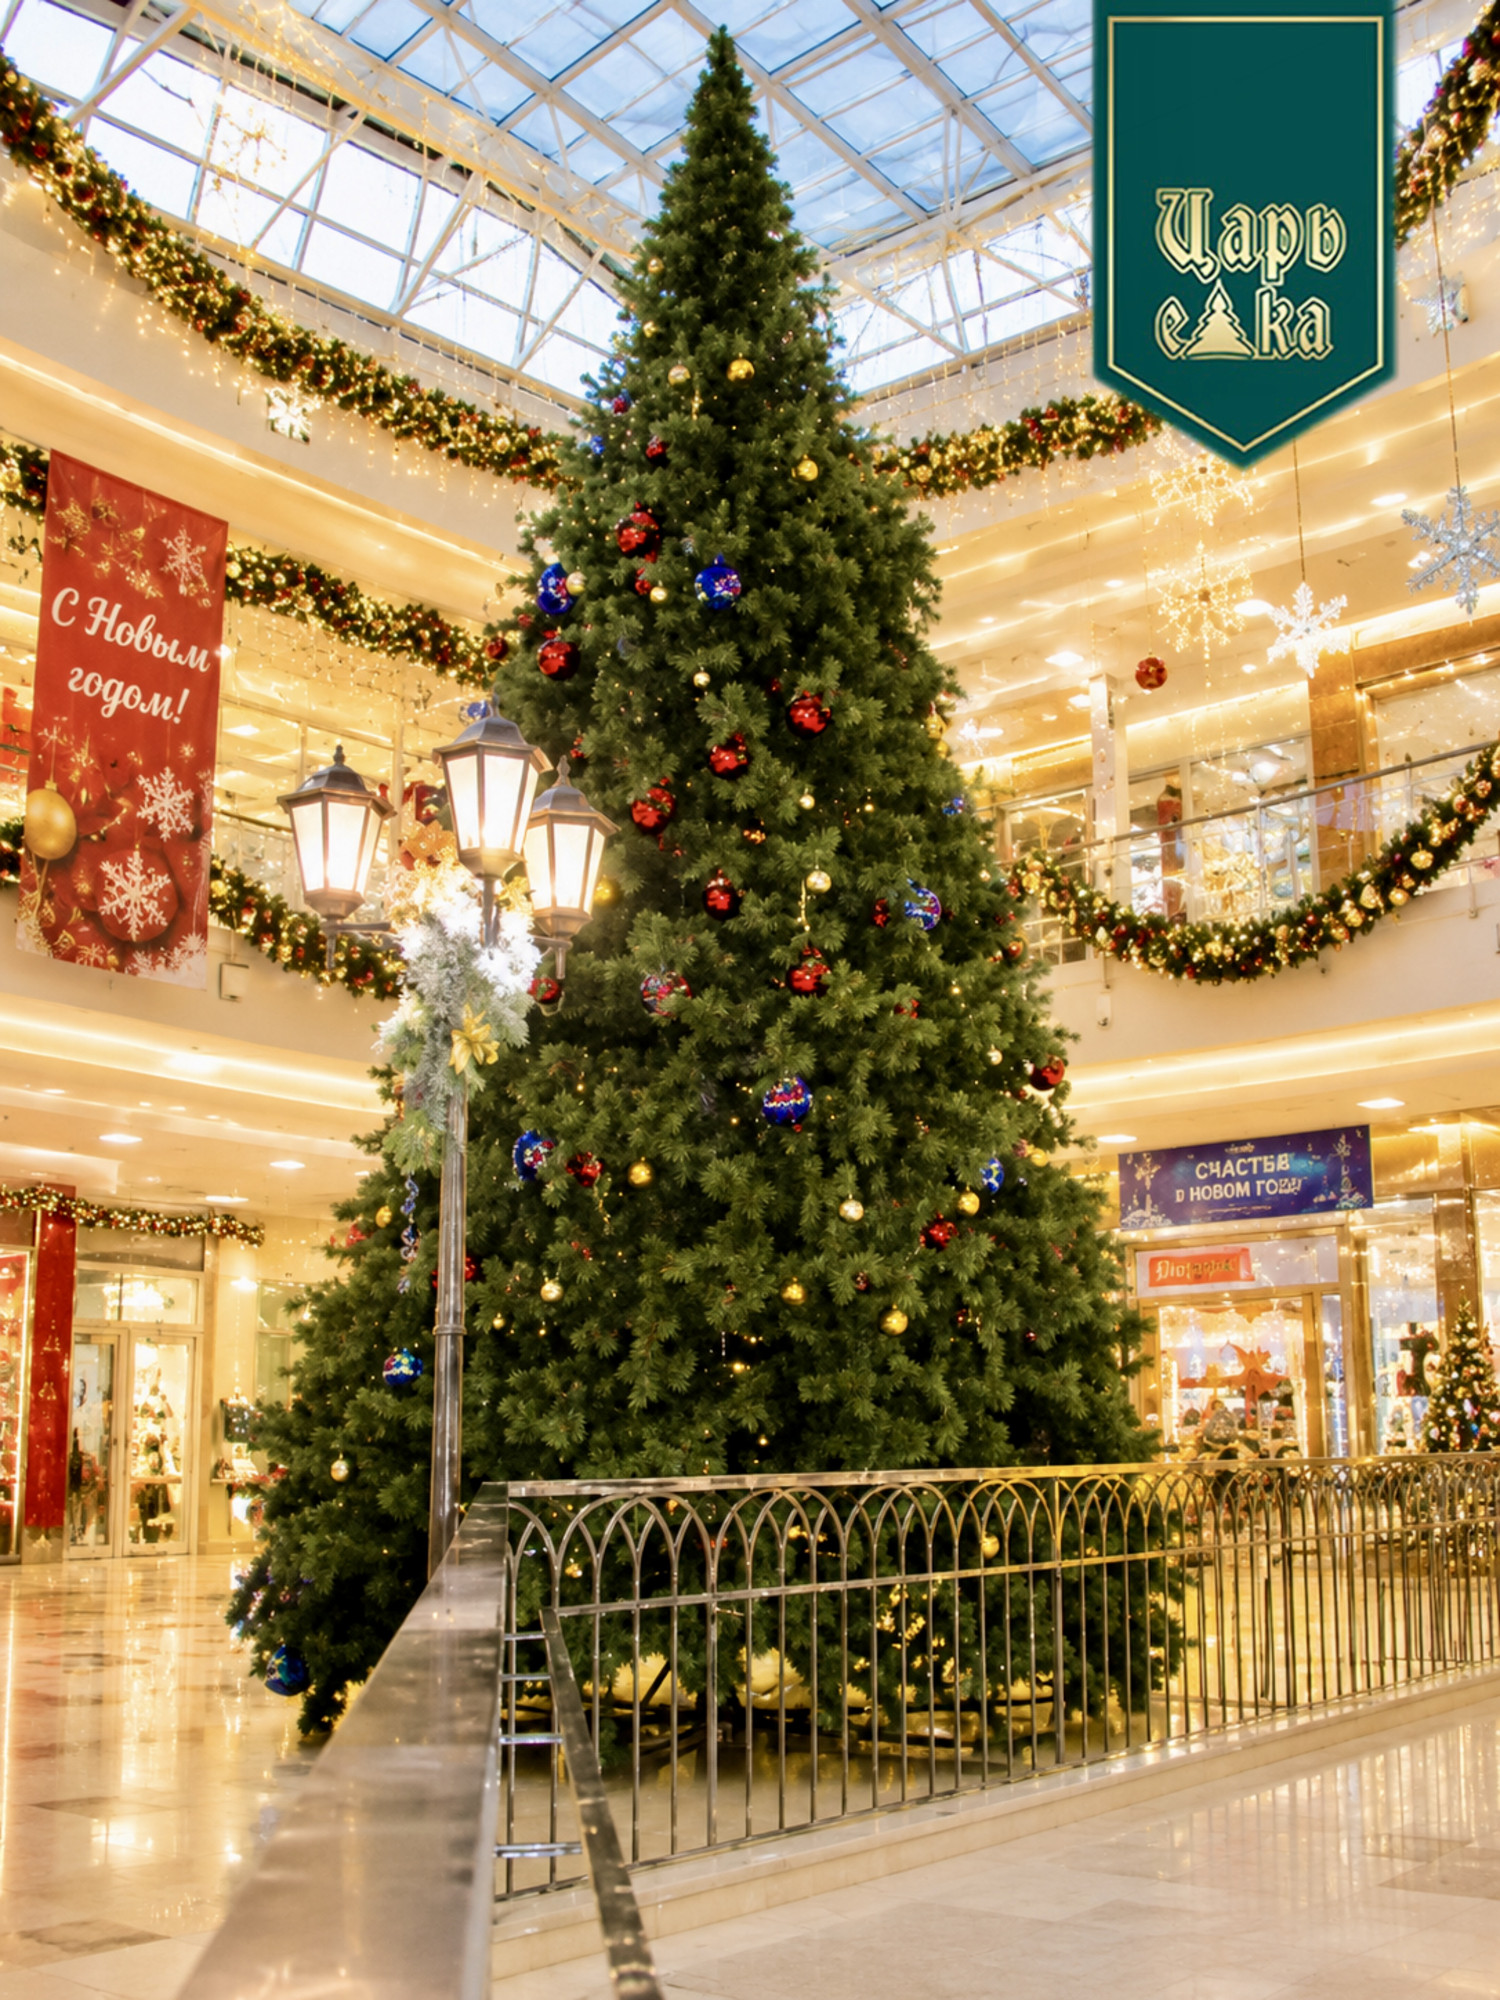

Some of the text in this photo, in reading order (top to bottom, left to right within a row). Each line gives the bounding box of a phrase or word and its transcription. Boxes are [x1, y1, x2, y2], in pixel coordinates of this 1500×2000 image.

[51, 587, 210, 672] С Новым
[67, 667, 190, 724] годом!
[1189, 1181, 1251, 1202] НОВОМ
